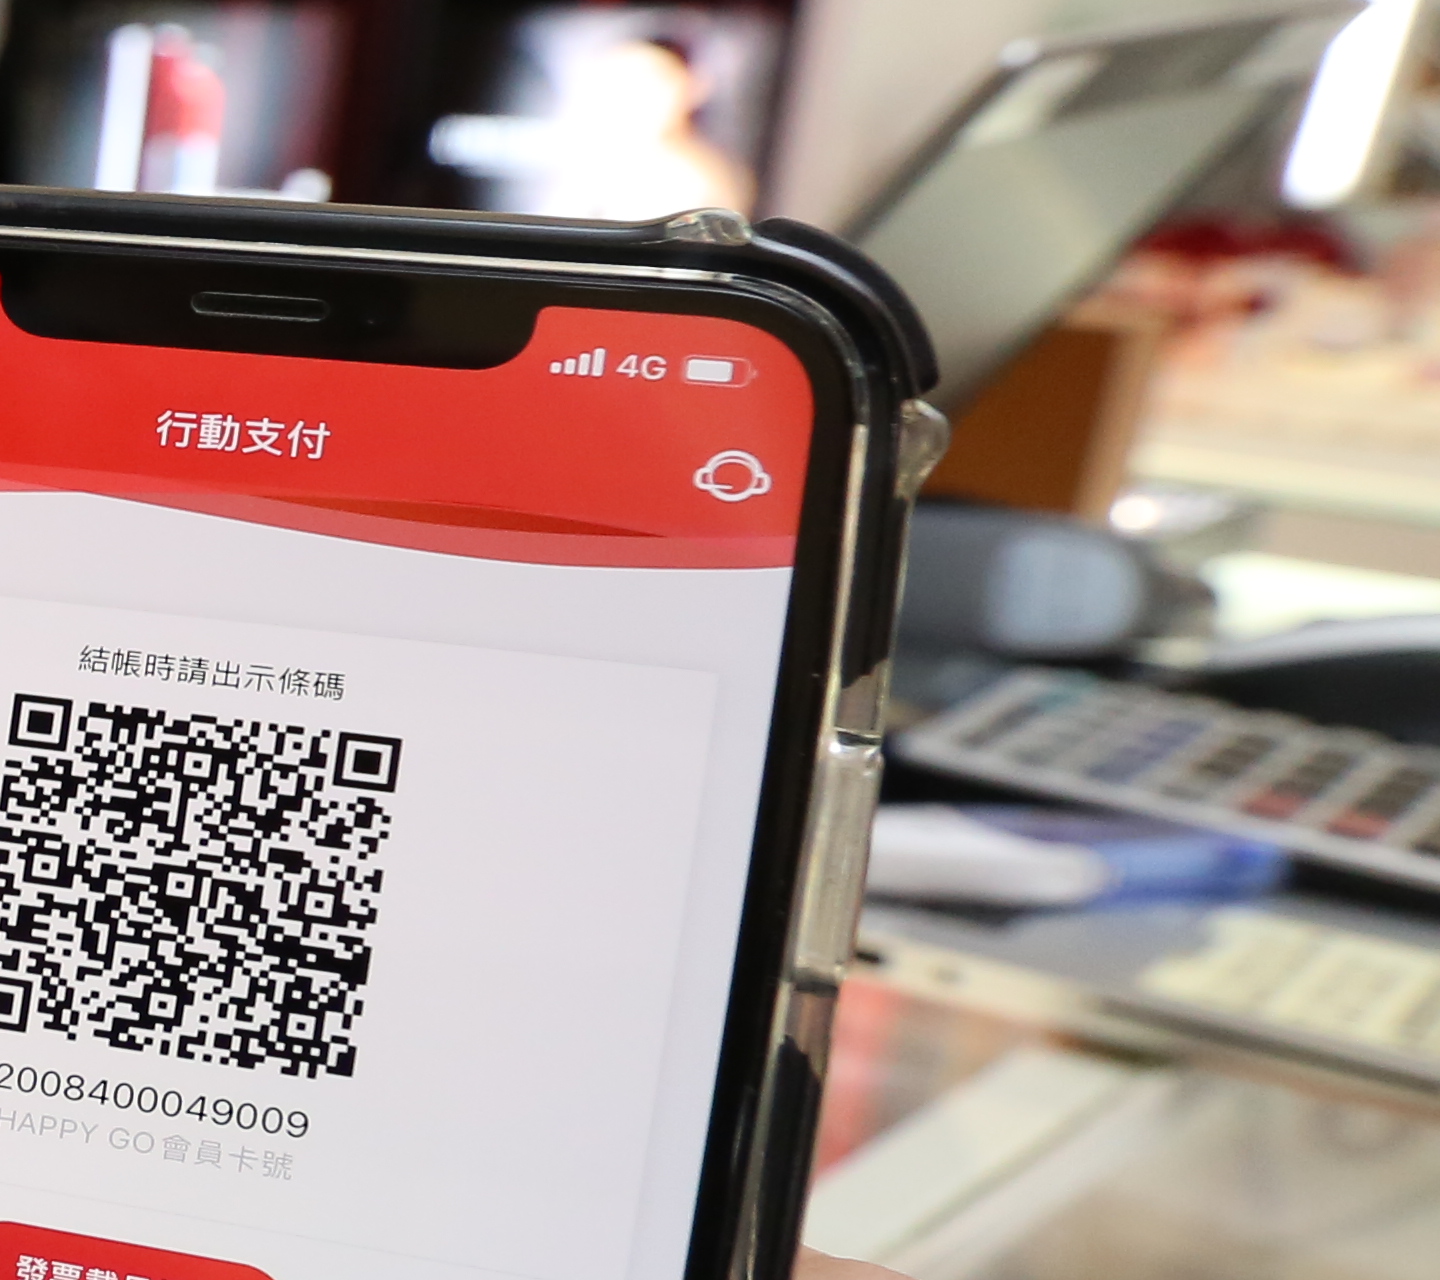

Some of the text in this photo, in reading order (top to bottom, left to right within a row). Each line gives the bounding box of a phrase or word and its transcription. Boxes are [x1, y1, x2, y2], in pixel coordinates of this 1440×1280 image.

[616, 355, 666, 379] 4G
[157, 411, 330, 459] 行動支付
[78, 646, 344, 700] 結帳時請出示條碼
